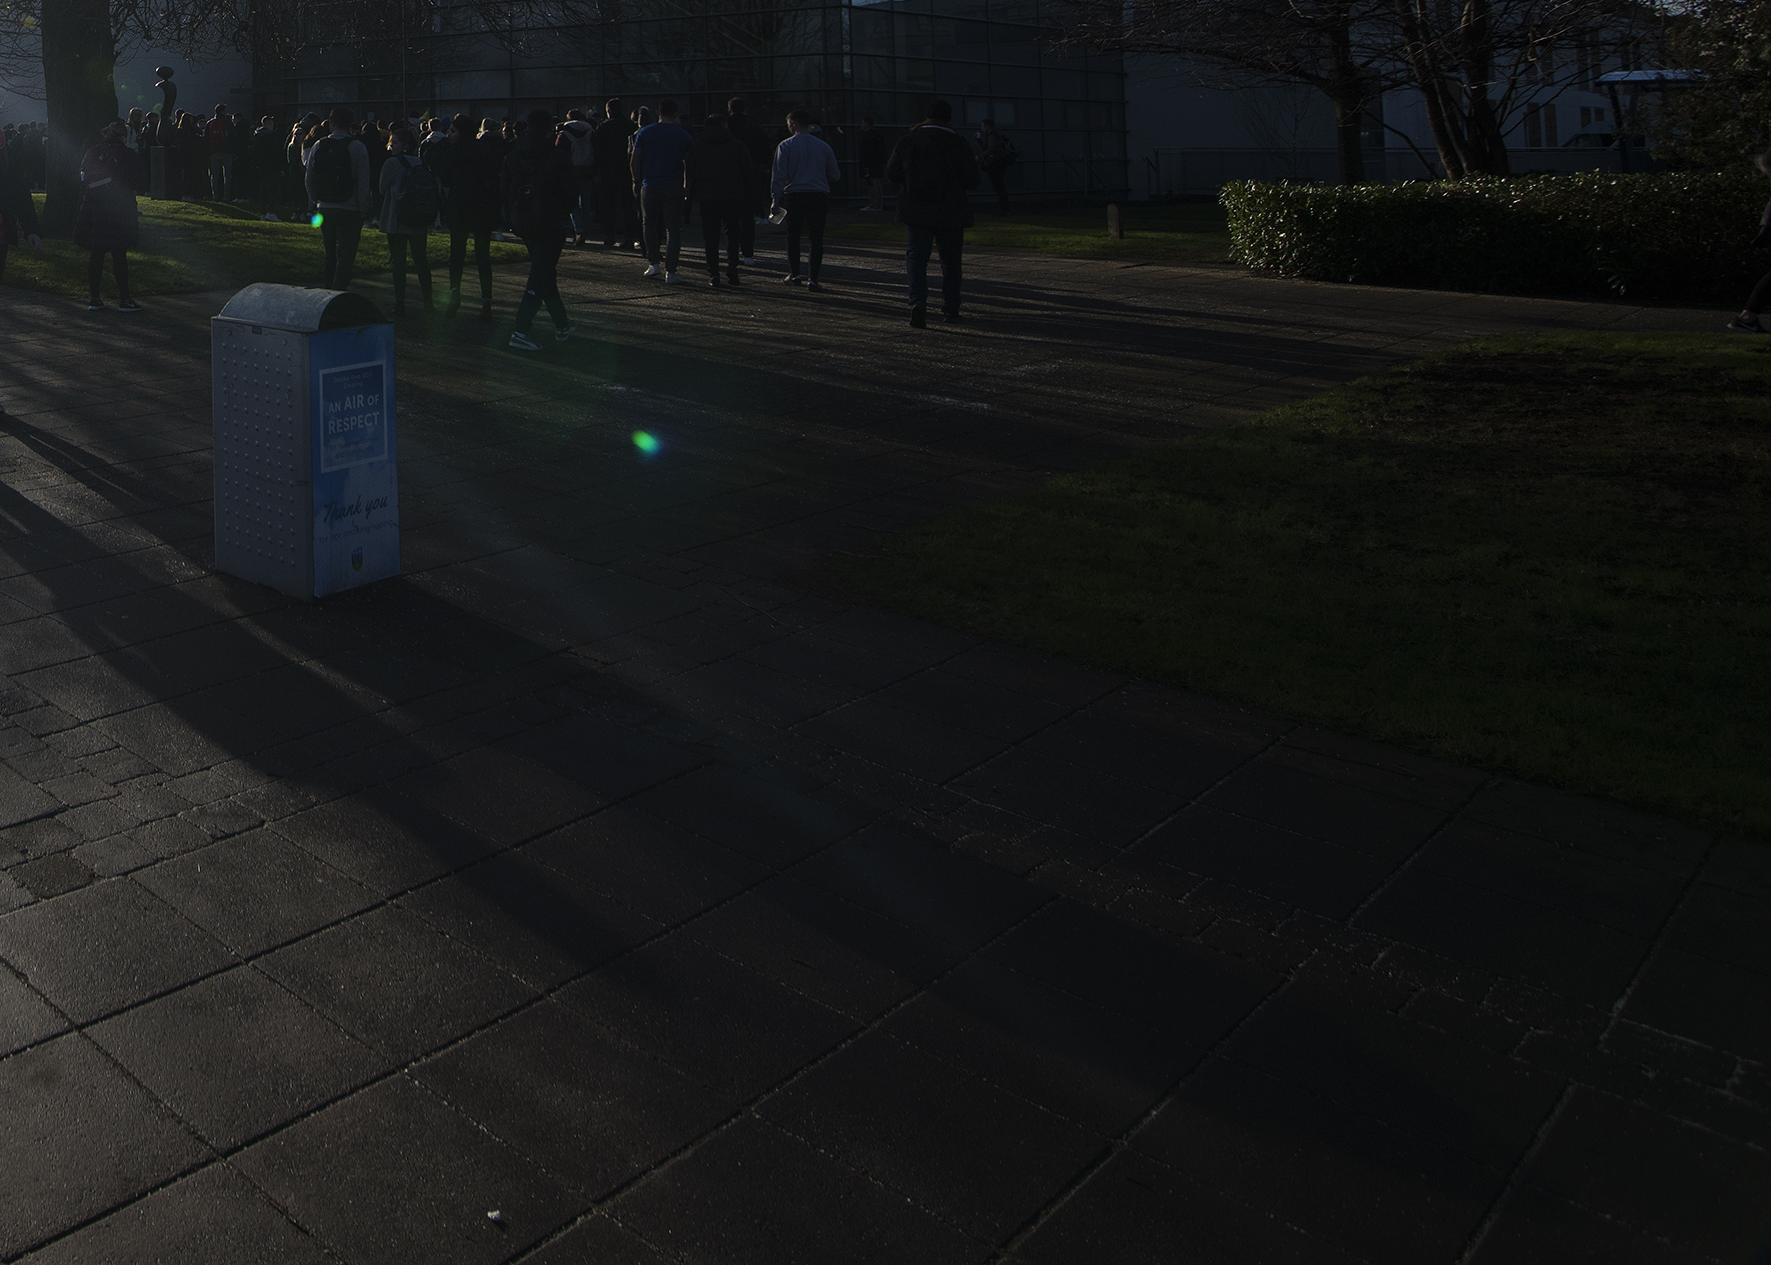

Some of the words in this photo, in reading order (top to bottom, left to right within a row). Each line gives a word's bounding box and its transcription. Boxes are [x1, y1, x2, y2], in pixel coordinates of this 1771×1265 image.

[328, 401, 341, 414] AN
[344, 394, 365, 411] AIR
[367, 394, 380, 406] OF
[328, 411, 380, 435] RESPECT
[323, 494, 363, 524] Thank
[365, 496, 389, 520] you
[319, 535, 328, 545] for
[330, 532, 342, 541] not
